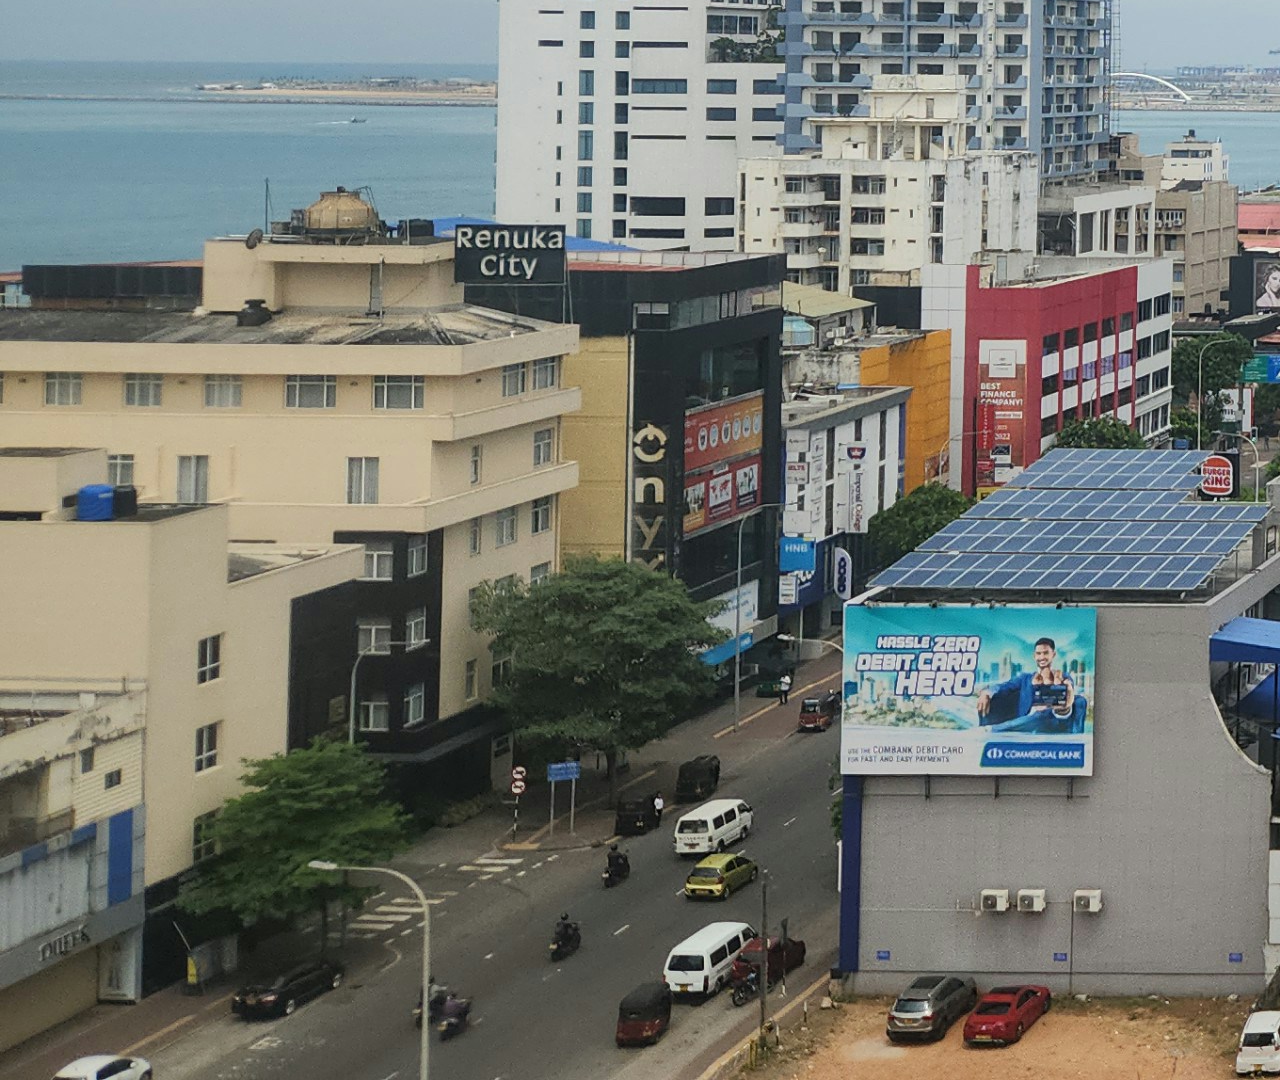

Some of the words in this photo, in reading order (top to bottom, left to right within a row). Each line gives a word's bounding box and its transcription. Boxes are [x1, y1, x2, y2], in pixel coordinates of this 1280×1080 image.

[456, 226, 563, 249] Renuka
[480, 252, 538, 280] City
[980, 382, 1001, 390] BEST
[980, 390, 1016, 398] FINANCE
[1203, 467, 1230, 475] BURGER
[1203, 476, 1230, 486] KING
[854, 472, 863, 502] Imperial
[785, 543, 808, 553] HNB
[876, 636, 931, 649] HASSLE
[932, 637, 980, 652] ZERO
[856, 653, 916, 670] DEBIT
[917, 652, 977, 671] CARD
[895, 671, 975, 695] HERO
[872, 745, 913, 754] COMBANK
[916, 745, 939, 754] DEBIT
[941, 746, 964, 754] CARD
[860, 755, 877, 763] FAST
[880, 755, 893, 763] AND
[1004, 750, 1057, 760] COMMERCIAL
[1058, 750, 1083, 760] BANK
